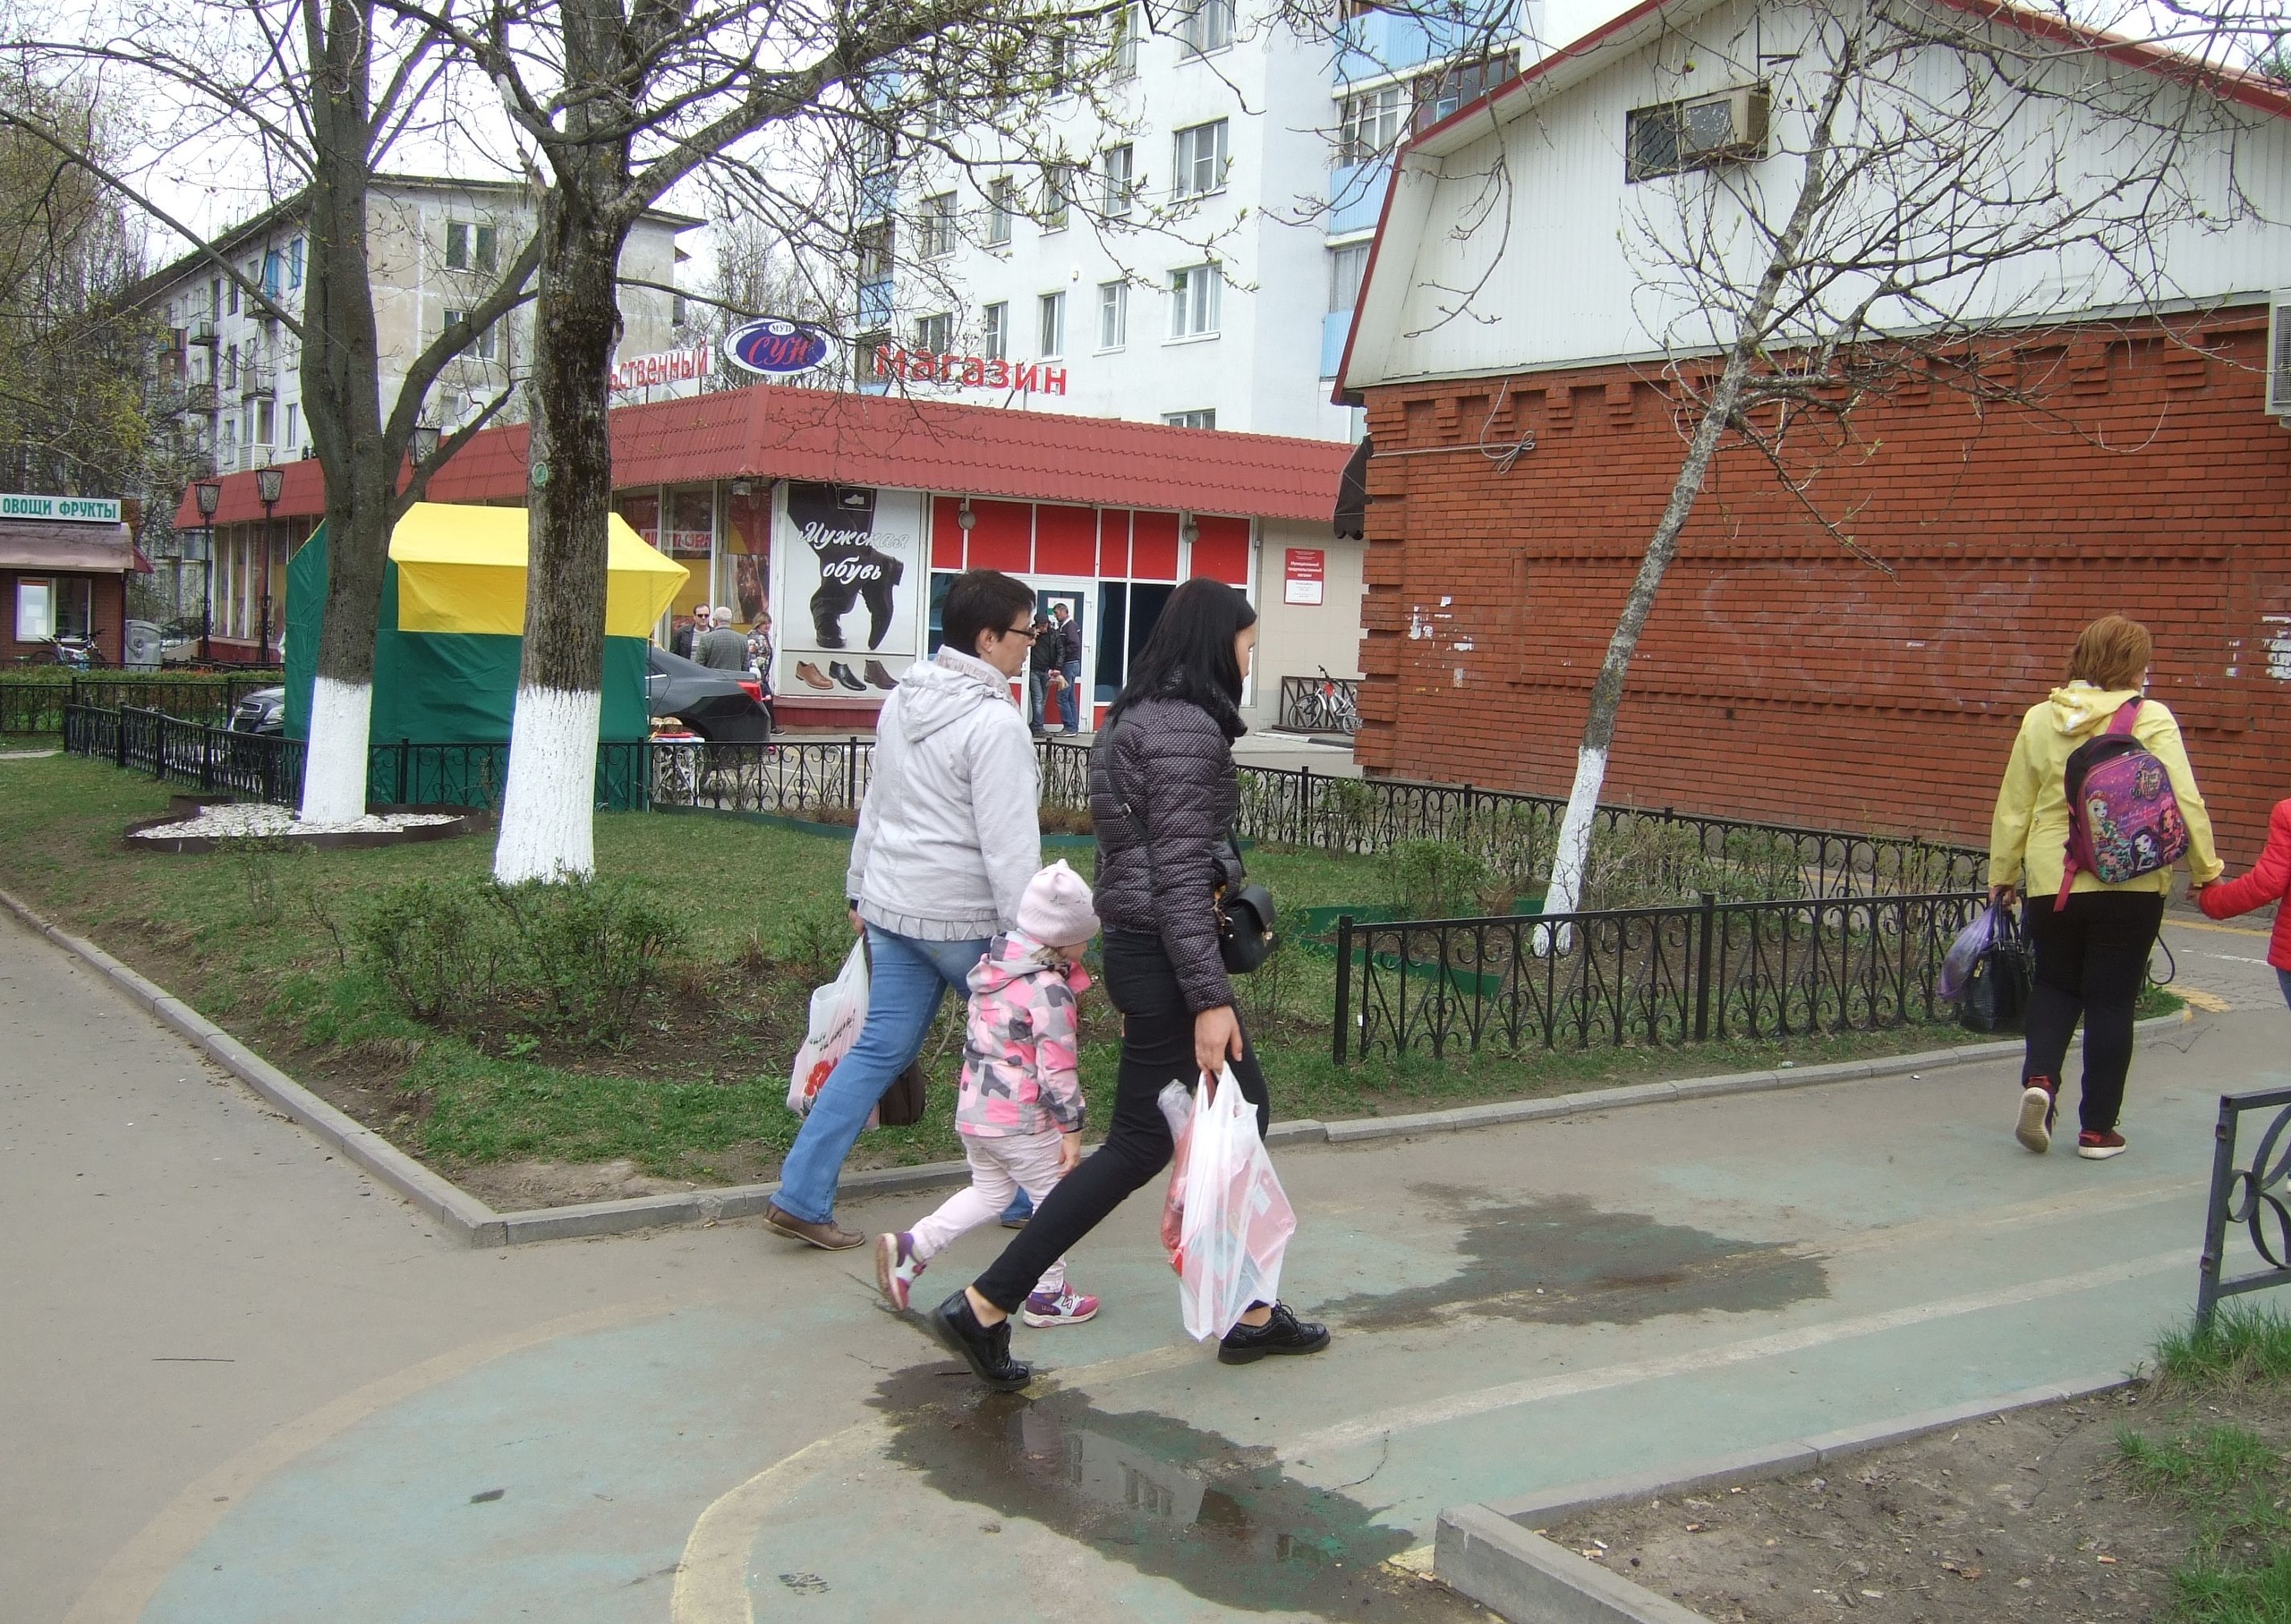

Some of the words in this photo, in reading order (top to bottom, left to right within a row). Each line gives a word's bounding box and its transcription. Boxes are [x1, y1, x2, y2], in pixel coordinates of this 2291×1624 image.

[771, 325, 792, 333] МУП
[3, 497, 52, 516] ОВОЩИ
[59, 501, 116, 519] ФРУКТЫ
[796, 521, 910, 550] Мужская
[822, 556, 882, 585] обувь
